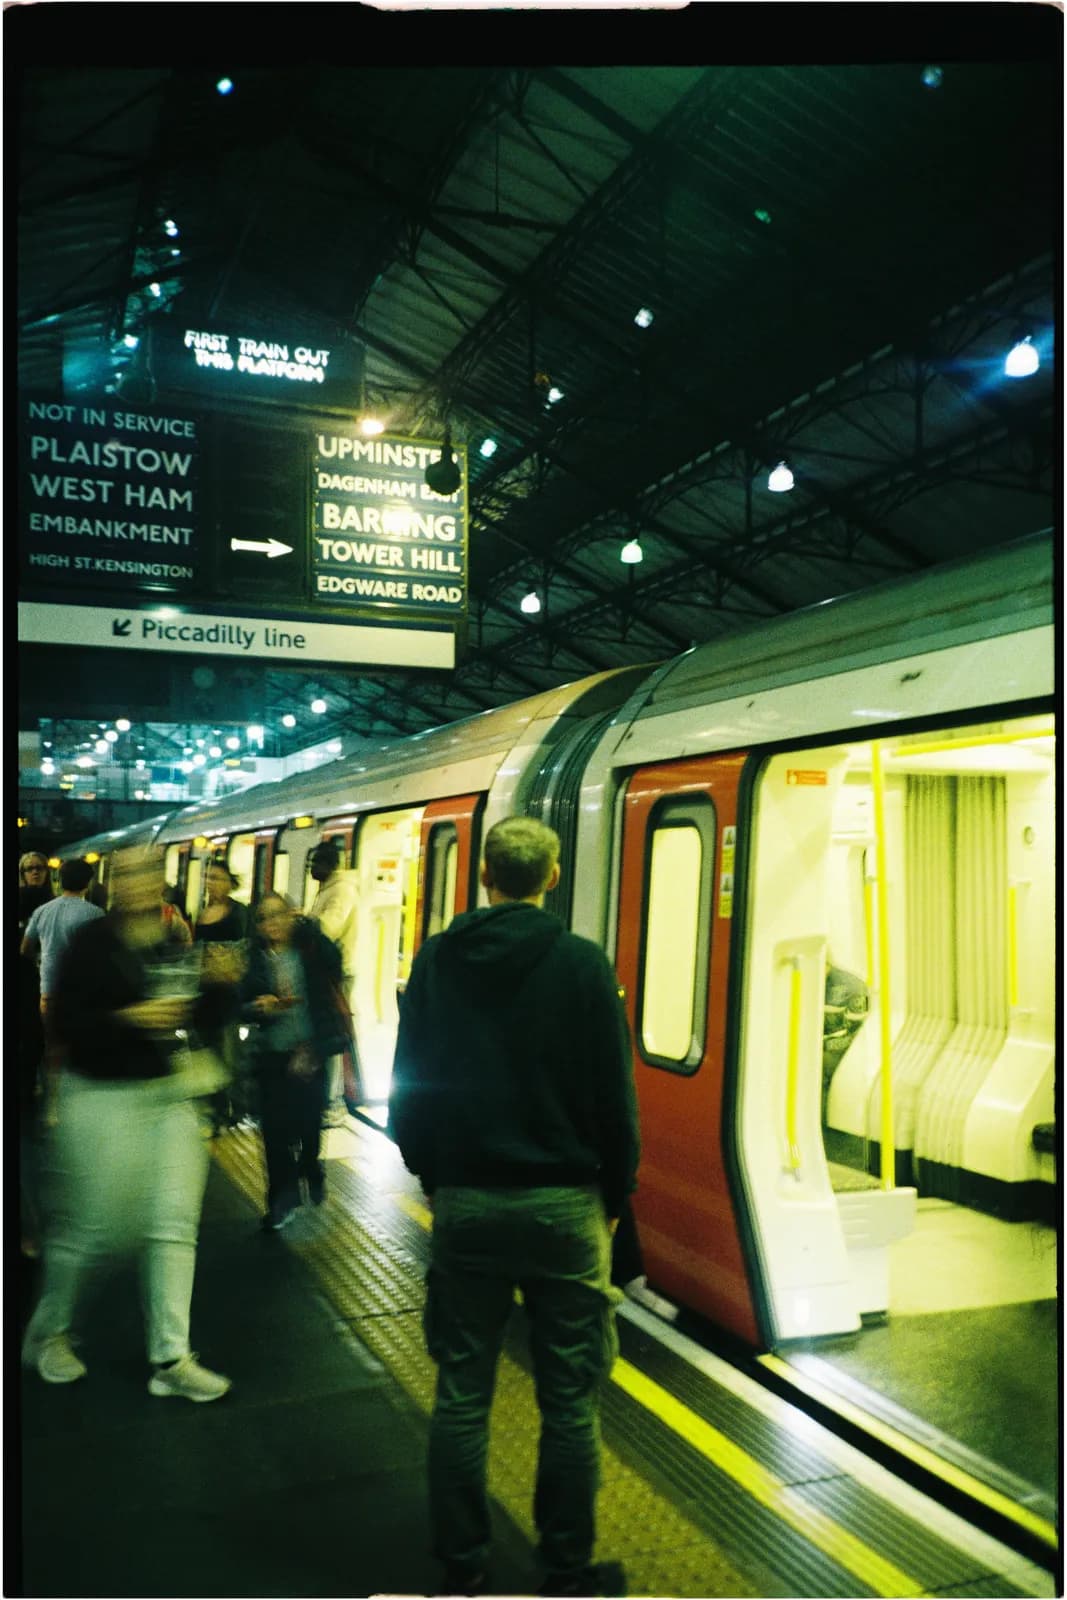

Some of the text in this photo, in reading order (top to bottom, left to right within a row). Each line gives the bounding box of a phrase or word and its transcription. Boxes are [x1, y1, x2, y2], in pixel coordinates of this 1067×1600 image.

[184, 330, 330, 367] FIRST TRAIN OUT
[237, 354, 325, 384] PLATFORM
[29, 401, 195, 438] NOT IN SERVICE
[31, 435, 193, 477] PLAISTOW
[318, 434, 458, 469] UPMINSTE
[29, 472, 193, 512] WEST HAM
[318, 472, 417, 499] DAGENHAM
[29, 512, 193, 545] EMBANKMENT
[322, 502, 457, 542] BARNG
[29, 552, 70, 568] HIGH
[319, 539, 461, 573] TOWER HILL
[317, 575, 462, 603] EDGWARE ROAD
[142, 618, 307, 650] Piccadilly line
